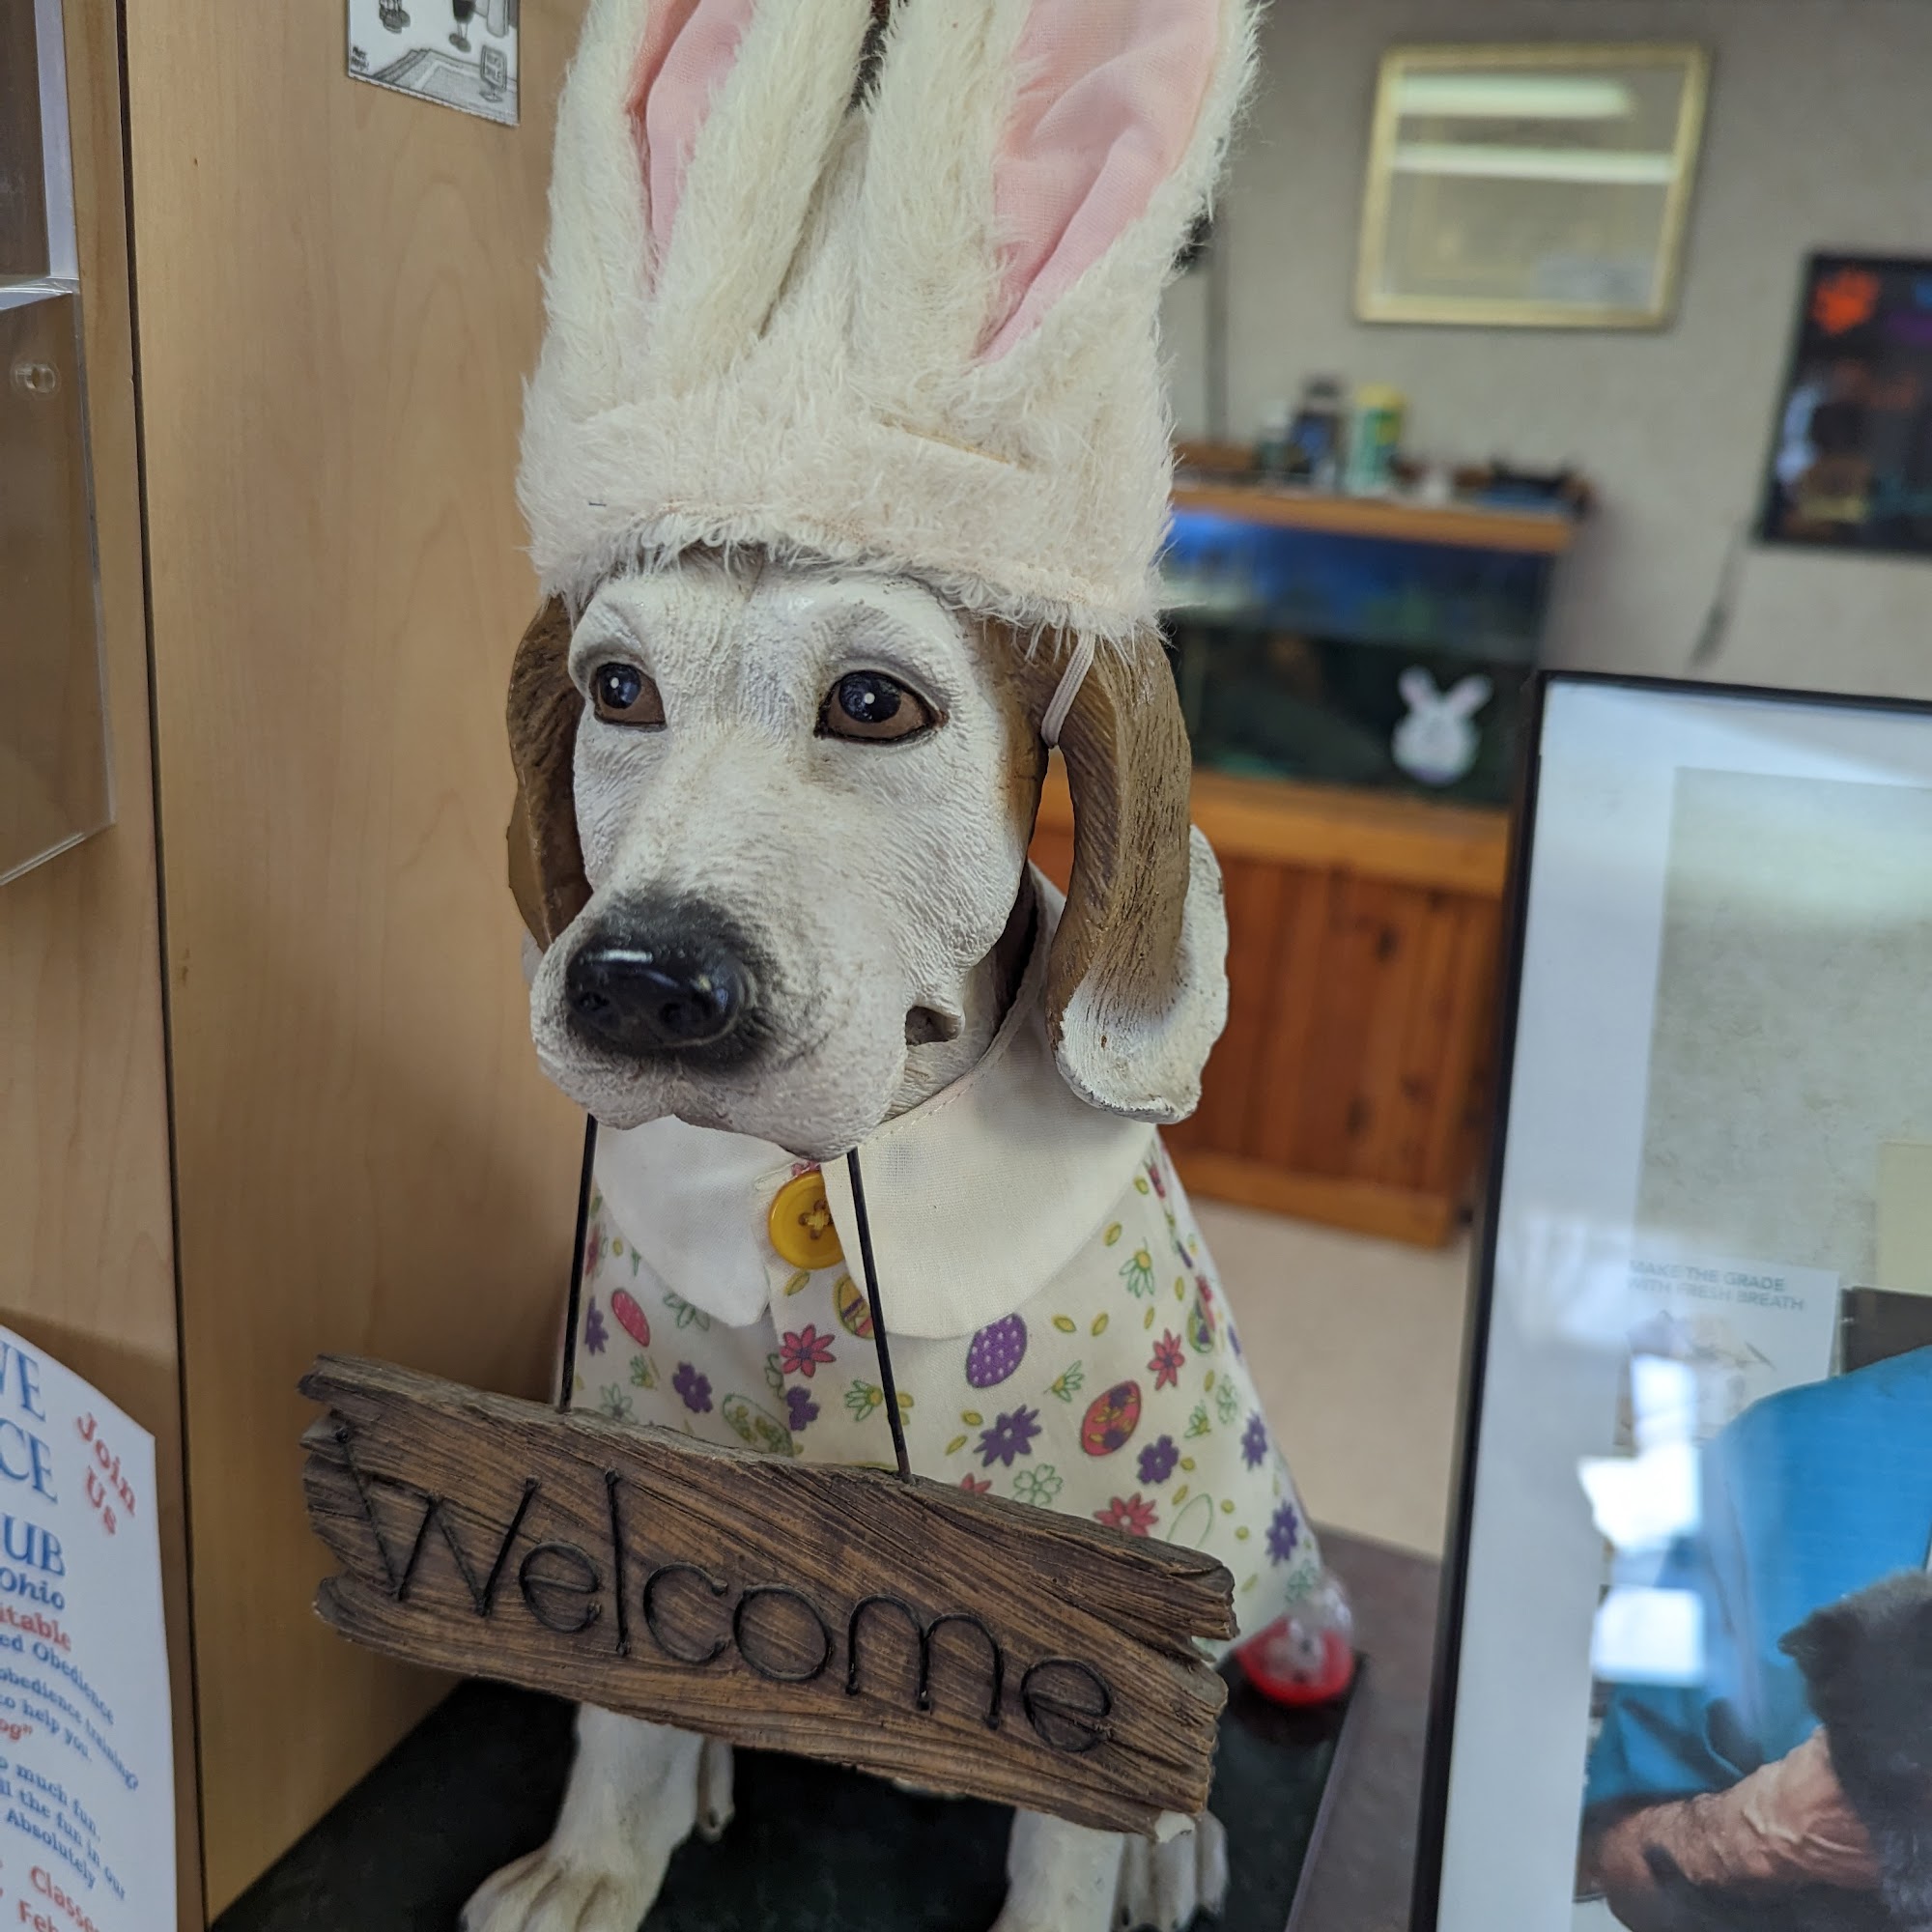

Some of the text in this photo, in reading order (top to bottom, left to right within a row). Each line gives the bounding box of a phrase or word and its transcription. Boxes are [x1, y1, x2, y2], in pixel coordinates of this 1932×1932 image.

[1686, 1265, 1719, 1283] THE
[1723, 1271, 1785, 1292] GRADE
[1736, 1290, 1804, 1312] BREATH
[0, 1567, 65, 1610] Ohio
[331, 1422, 1114, 1752] Welcome
[33, 1641, 114, 1726] Obedience
[22, 1698, 60, 1734] help
[16, 1763, 68, 1805] much
[19, 1789, 50, 1818] the
[57, 1811, 83, 1847] fun
[7, 1808, 96, 1890] Absolutely
[30, 1864, 100, 1932] Classe
